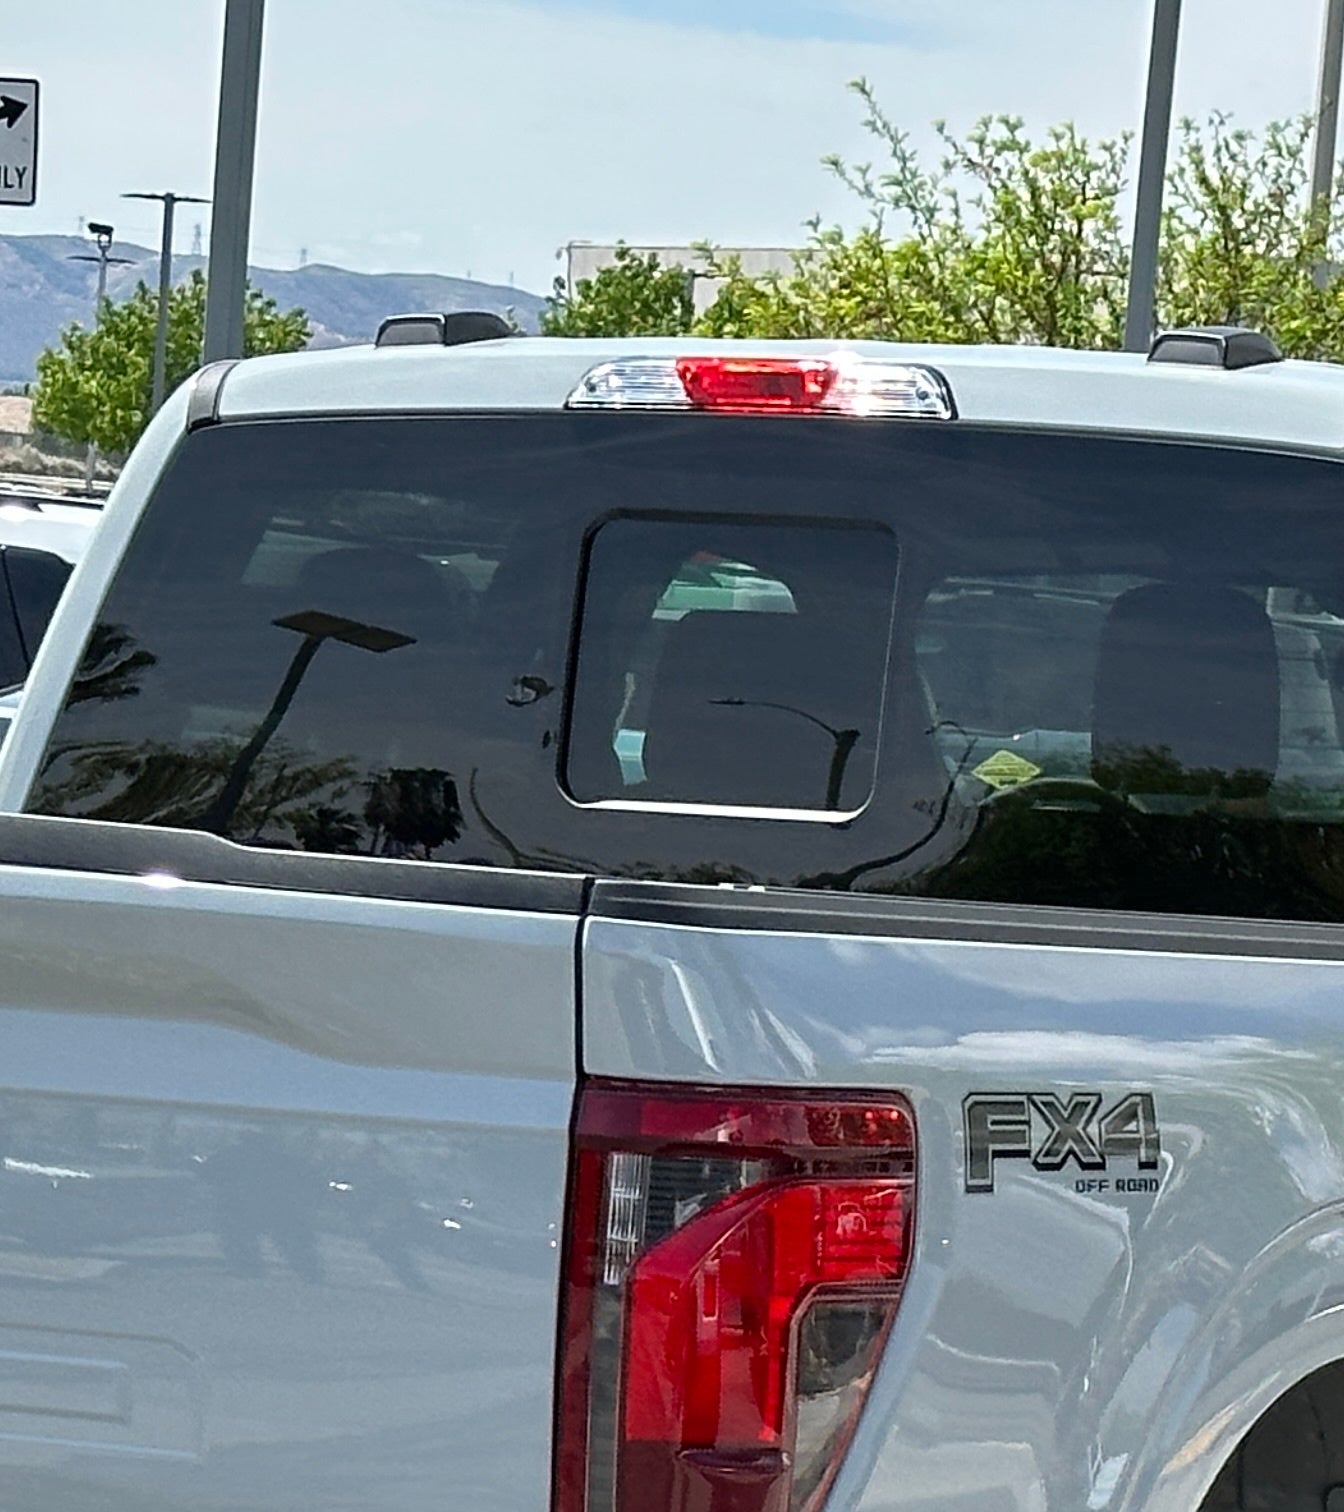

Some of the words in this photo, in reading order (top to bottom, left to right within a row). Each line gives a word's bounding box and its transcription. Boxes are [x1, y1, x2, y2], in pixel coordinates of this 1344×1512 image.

[962, 1091, 1161, 1193] FX4
[1075, 1177, 1110, 1193] OFF
[1116, 1178, 1160, 1193] ROAD
